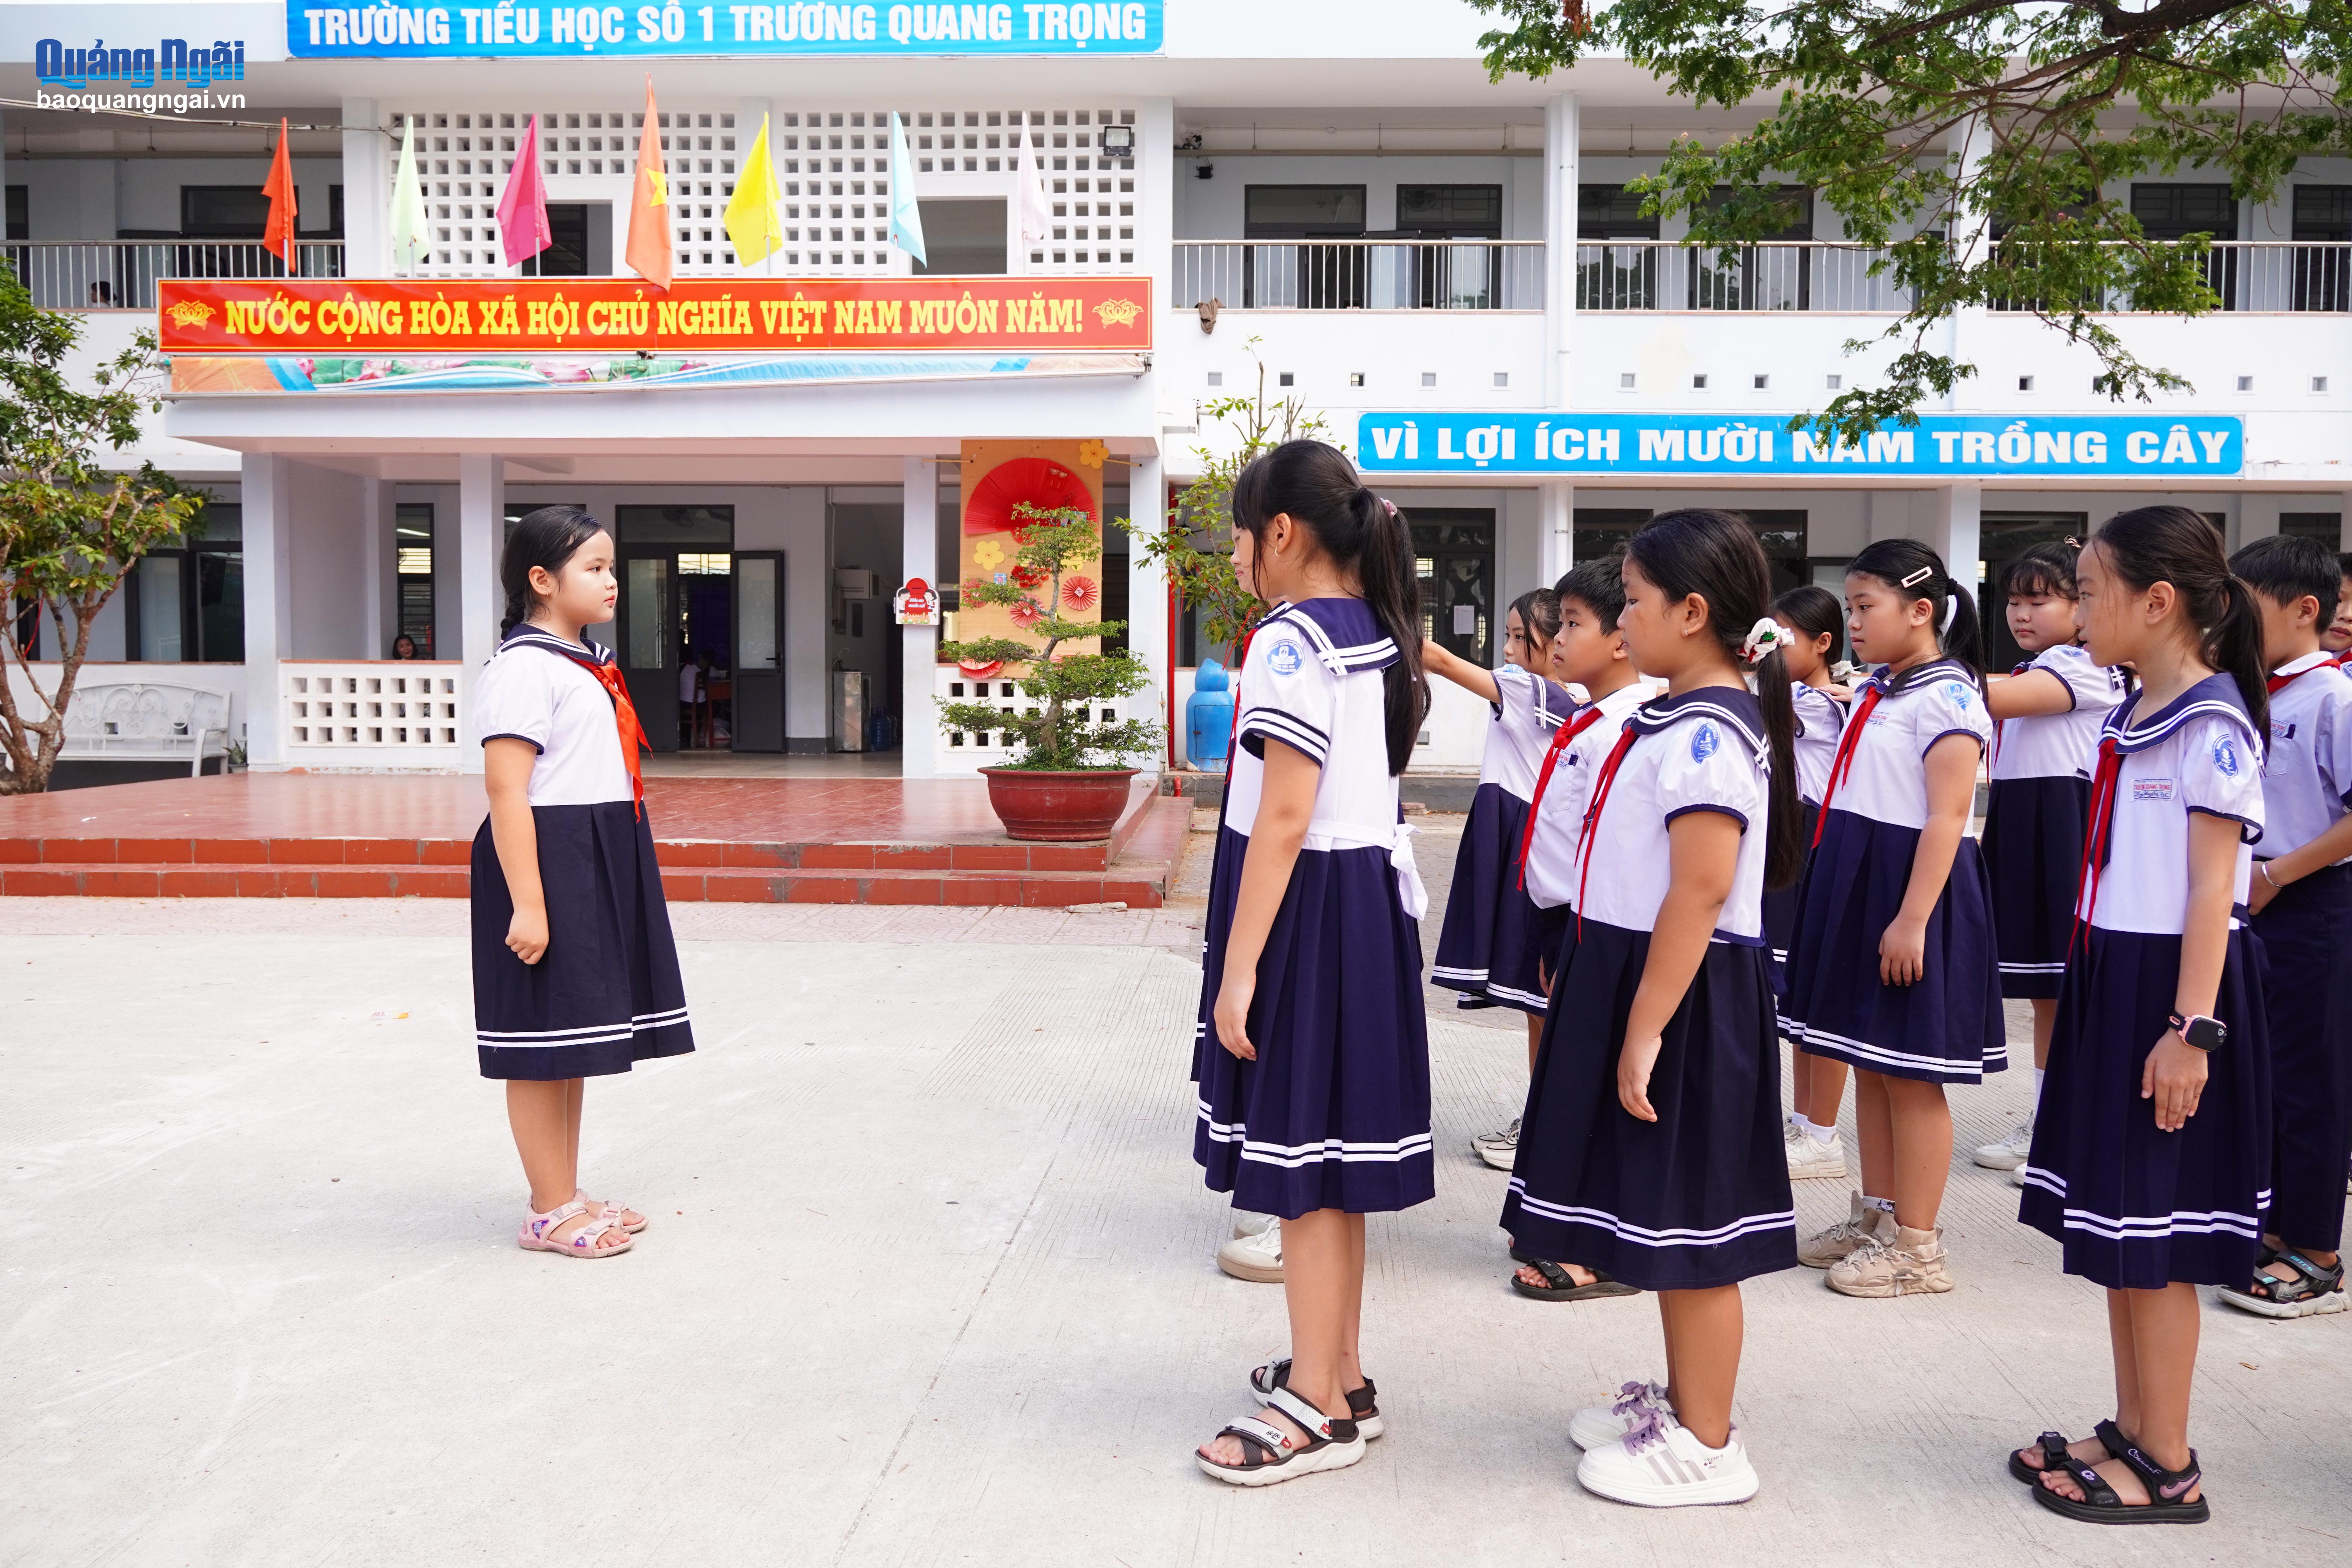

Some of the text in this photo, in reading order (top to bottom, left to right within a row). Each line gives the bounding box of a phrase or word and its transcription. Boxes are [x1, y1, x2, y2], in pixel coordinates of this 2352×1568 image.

[304, 0, 450, 45] TRƯỜNG
[552, 6, 624, 51] HỌC
[697, 6, 713, 41] 1
[729, 1, 876, 41] TRƯƠNG
[888, 4, 1012, 45] QUANG
[1023, 3, 1145, 48] TRỌNG
[225, 289, 1083, 343] NƯỚC CỘNG HÒA XÃ HỘI CHỦ NGHĨA VIỆT NAM MUÔN NĂM!
[1372, 421, 1418, 459] VÌ
[1438, 425, 1515, 466] LỢI
[1535, 422, 1620, 461] ÍCH
[1639, 423, 1773, 462] MƯỜI
[1932, 421, 2107, 463] TRỒNG
[2127, 425, 2229, 463] CÂY
